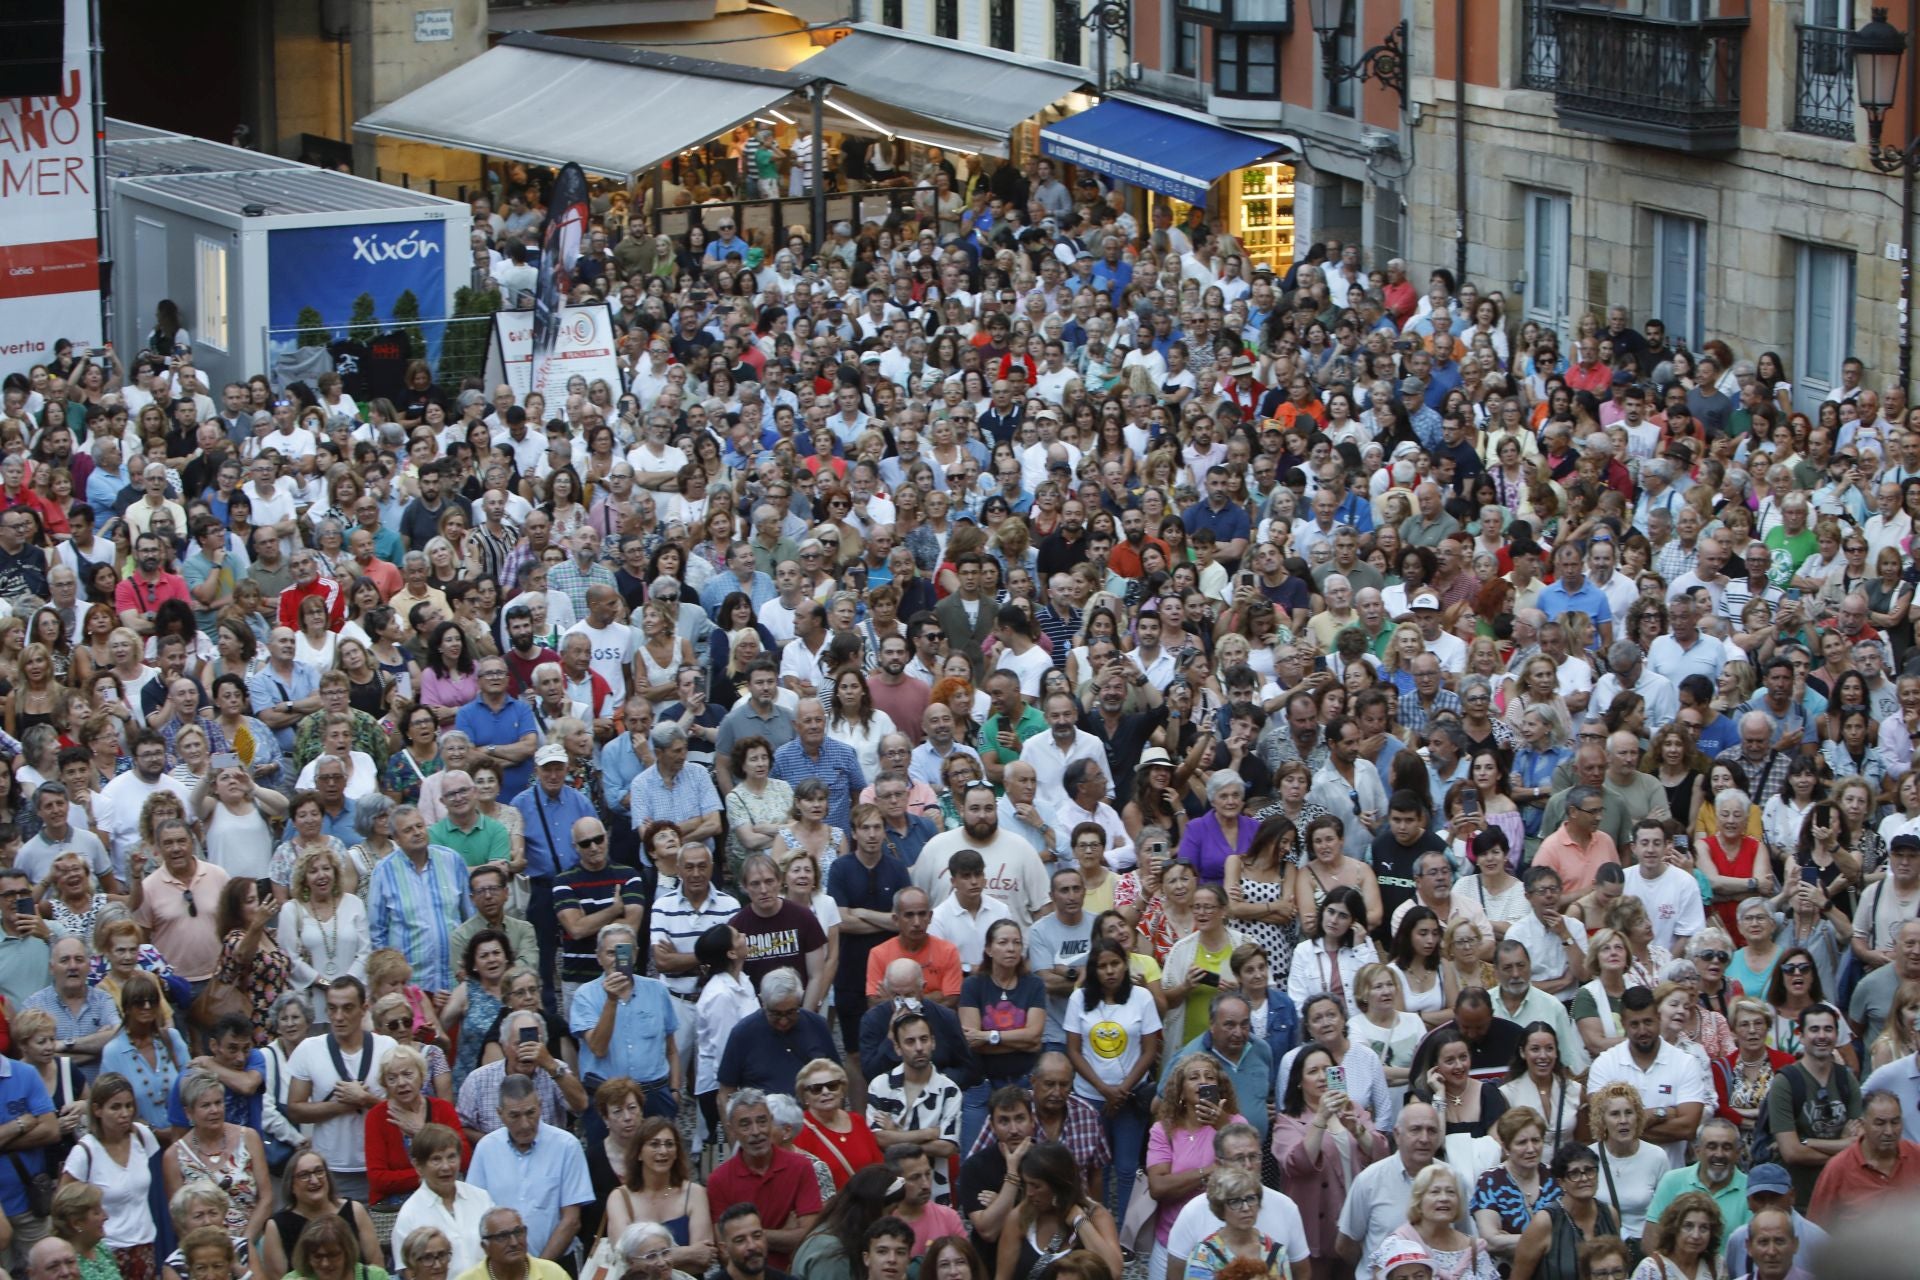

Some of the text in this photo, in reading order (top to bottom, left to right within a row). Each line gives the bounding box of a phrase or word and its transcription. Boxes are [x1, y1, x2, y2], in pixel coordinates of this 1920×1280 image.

[3, 157, 89, 198] MER
[353, 230, 440, 265] Xixón
[594, 647, 621, 661] OSS
[1061, 939, 1089, 955] NIKE
